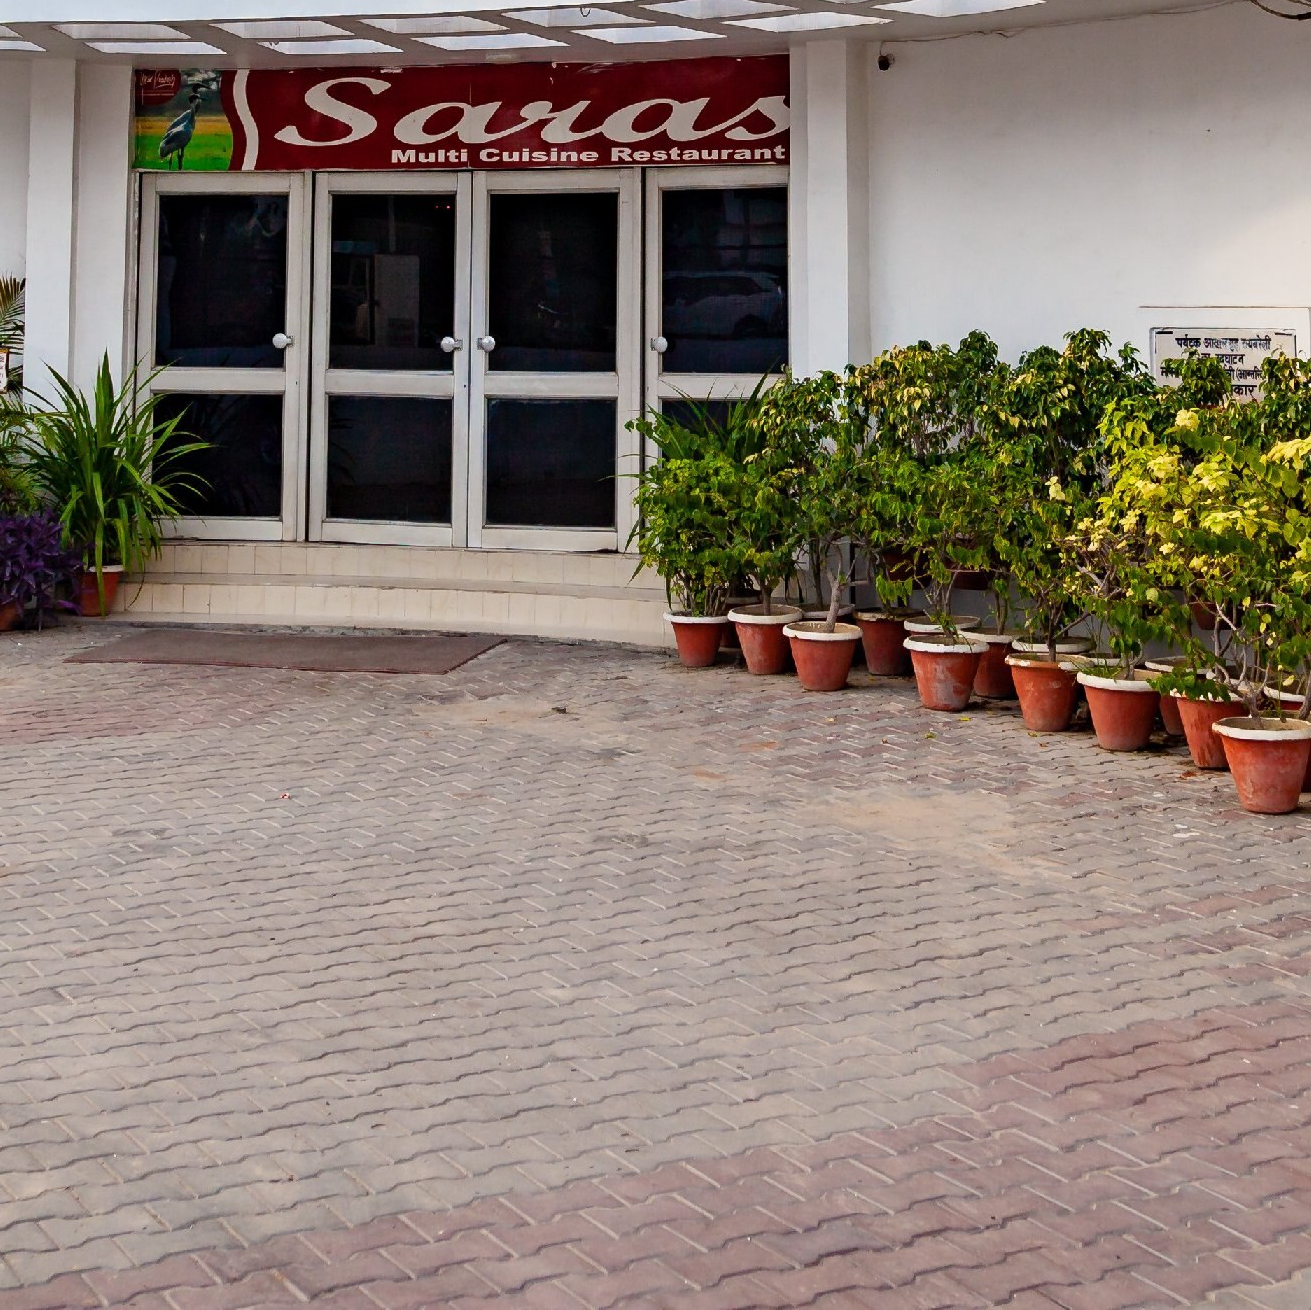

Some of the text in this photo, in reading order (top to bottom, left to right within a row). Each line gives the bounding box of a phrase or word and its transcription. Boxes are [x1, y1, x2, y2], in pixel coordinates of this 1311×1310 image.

[274, 77, 790, 147] Saras
[391, 145, 786, 164] Multi Cuisine Restaurant
